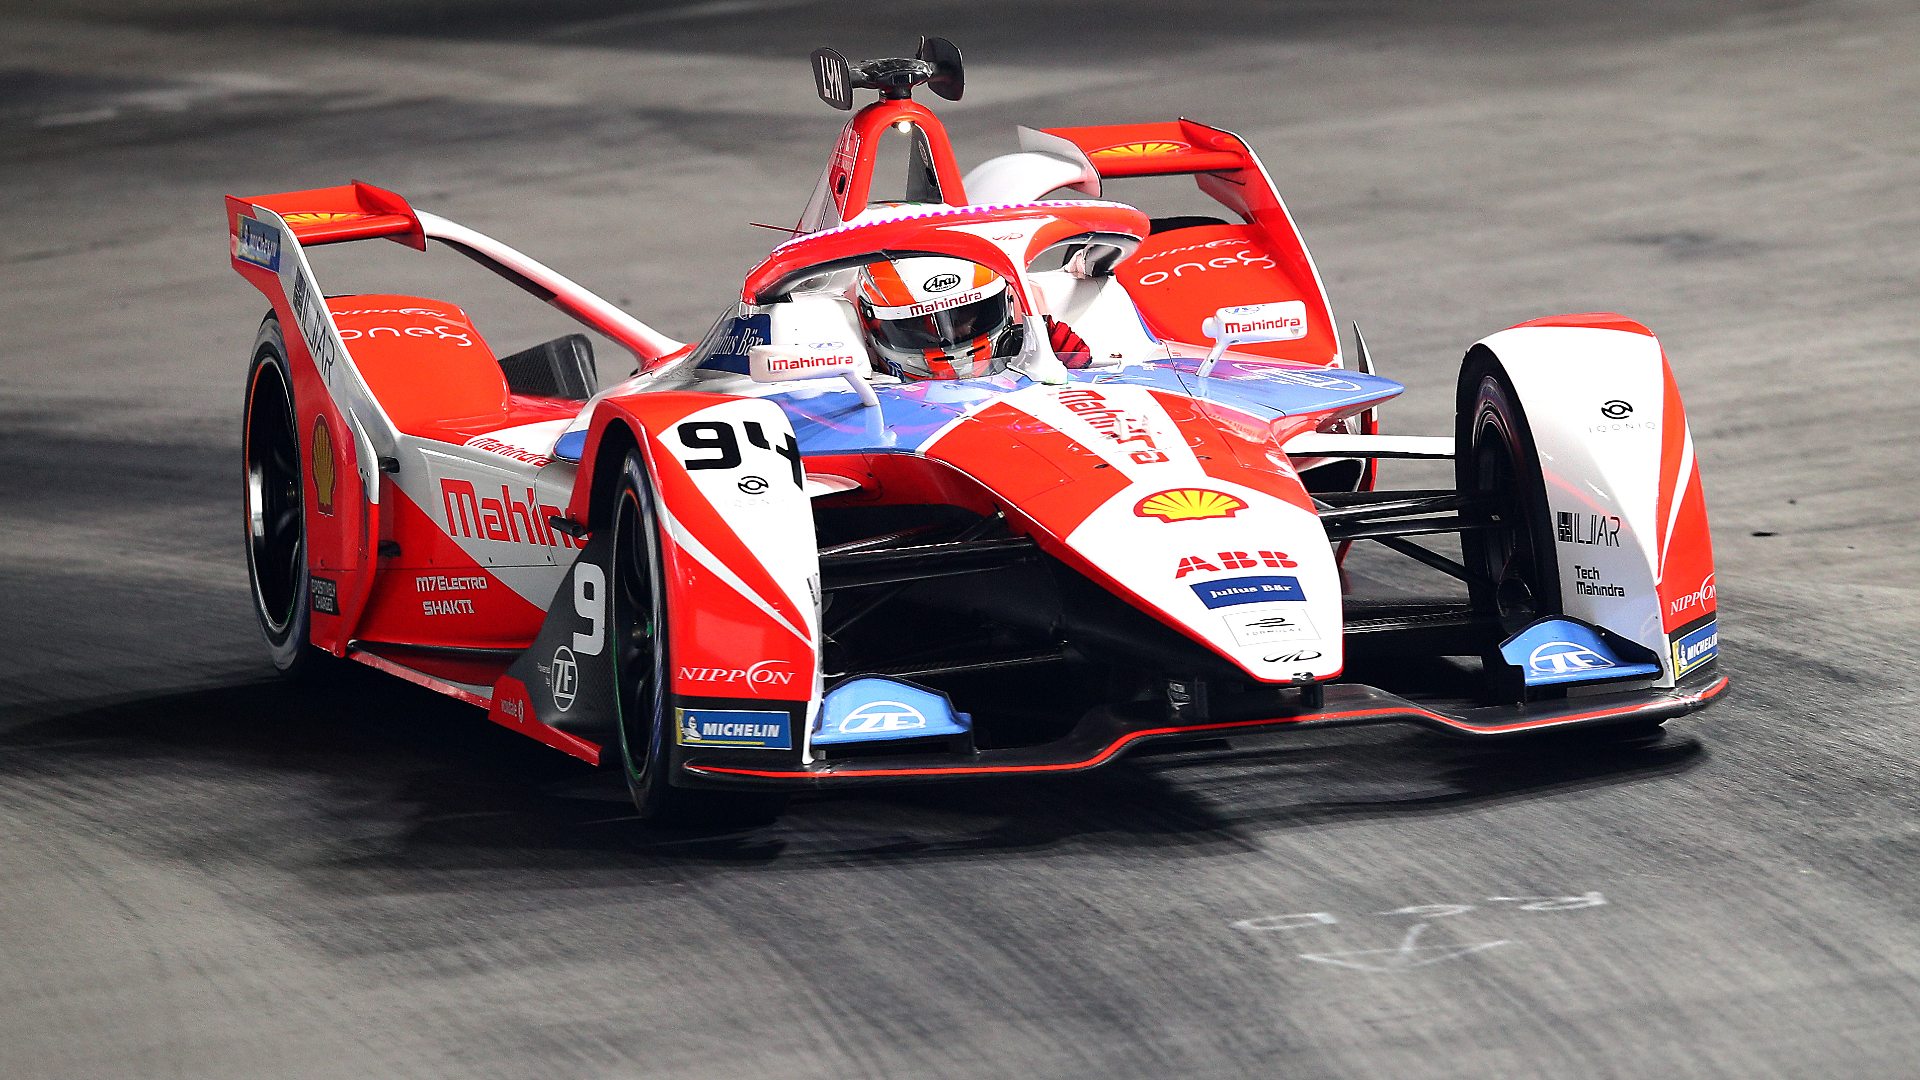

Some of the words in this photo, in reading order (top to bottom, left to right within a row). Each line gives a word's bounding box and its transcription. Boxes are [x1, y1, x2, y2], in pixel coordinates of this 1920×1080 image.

[1225, 317, 1300, 334] Mahindra
[711, 328, 738, 355] ulius
[772, 355, 854, 371] Mahindra
[677, 421, 803, 491] 94
[1175, 550, 1298, 579] ABB
[1574, 565, 1600, 580] Tech
[1209, 585, 1258, 599] Julius
[1576, 581, 1625, 597] Mahindra
[422, 600, 475, 616] SHAKTI
[553, 654, 577, 703] ZF
[678, 662, 796, 690] NIPPON
[702, 722, 781, 738] MICHELIN
